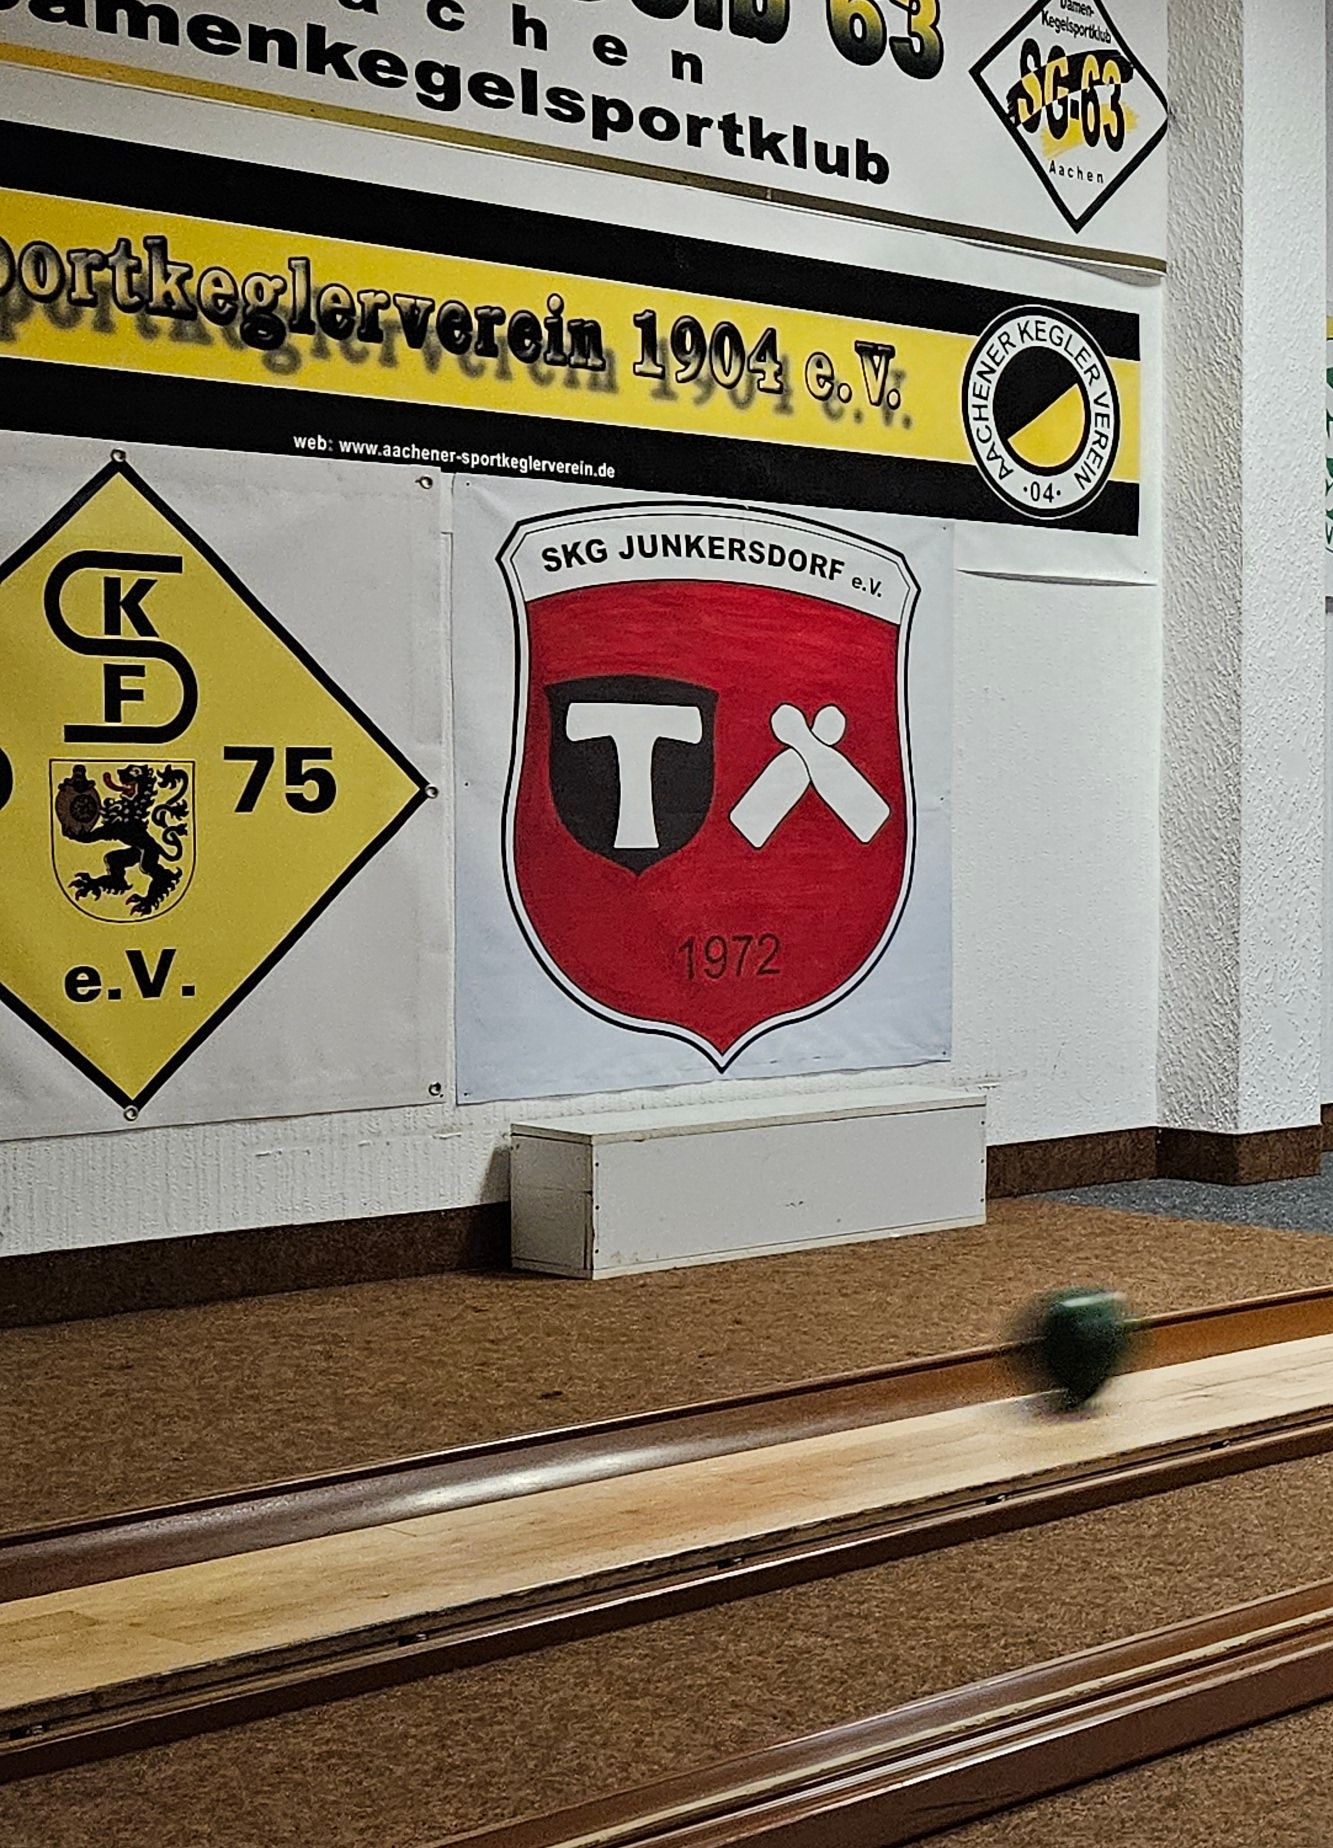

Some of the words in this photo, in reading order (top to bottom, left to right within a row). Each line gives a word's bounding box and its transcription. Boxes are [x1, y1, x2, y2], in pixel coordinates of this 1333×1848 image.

[826, 0, 944, 80] 63
[1041, 10, 1112, 44] Kegelsportklub
[0, 0, 890, 185] amenkegelsportklub
[1048, 160, 1104, 184] Aachen
[632, 308, 784, 394] 1904
[804, 340, 902, 410] e.V.
[972, 330, 1017, 481] AACHENER
[1016, 319, 1101, 387] KEGLER
[1073, 390, 1111, 491] VEREIN
[293, 435, 334, 452] web:
[338, 439, 616, 479] www.aachener-sportkeglerverein.de
[541, 538, 608, 573] SKG
[618, 534, 845, 582] JUNKERSDORF
[851, 574, 883, 598] e.V.
[223, 746, 337, 813] 75
[63, 949, 196, 1003] e.V.
[678, 932, 781, 981] 1972
